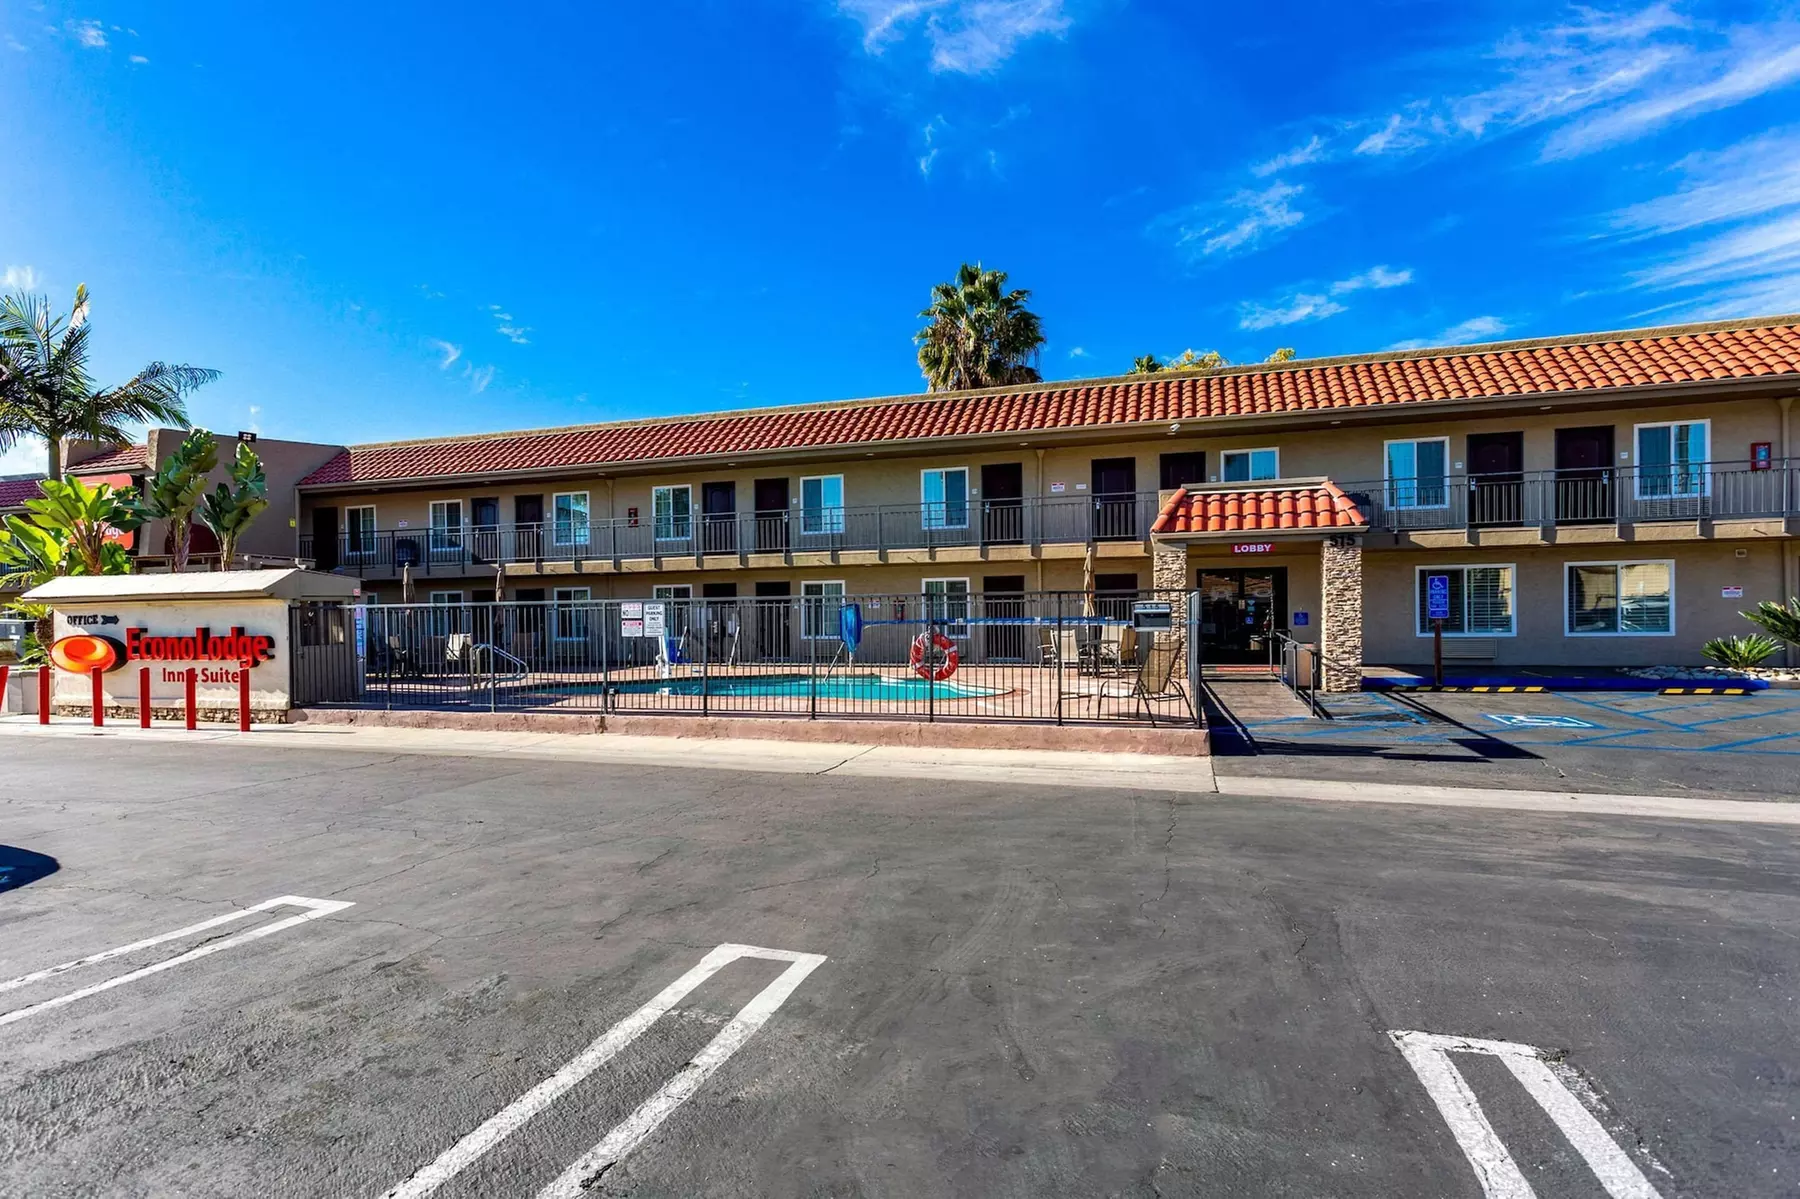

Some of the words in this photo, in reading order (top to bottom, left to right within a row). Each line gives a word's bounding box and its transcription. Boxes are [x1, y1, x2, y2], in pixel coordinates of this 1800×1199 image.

[1329, 534, 1356, 547] 515
[1234, 544, 1272, 553] LOBBY
[67, 614, 99, 626] OFFICE
[126, 626, 269, 669] EconoLodge
[163, 668, 185, 682] Inn
[201, 667, 240, 683] Suite
